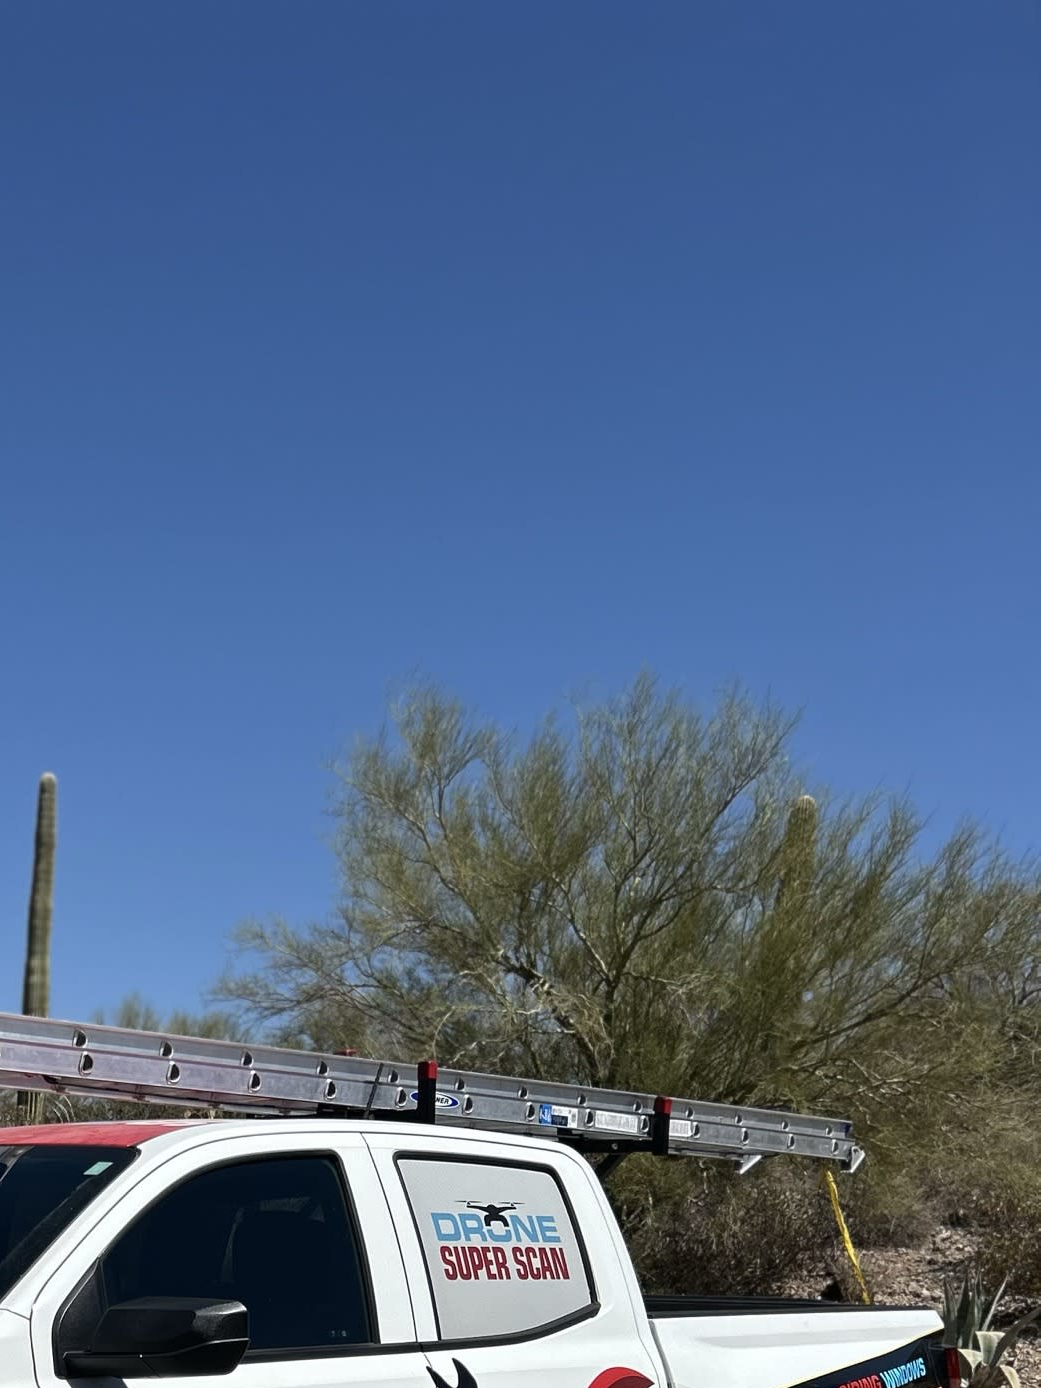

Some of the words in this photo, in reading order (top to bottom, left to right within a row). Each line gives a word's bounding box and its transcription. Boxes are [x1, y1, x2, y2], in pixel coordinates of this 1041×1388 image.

[431, 1212, 561, 1243] DRONE
[440, 1245, 511, 1281] SUPER
[512, 1246, 571, 1281] SCAN
